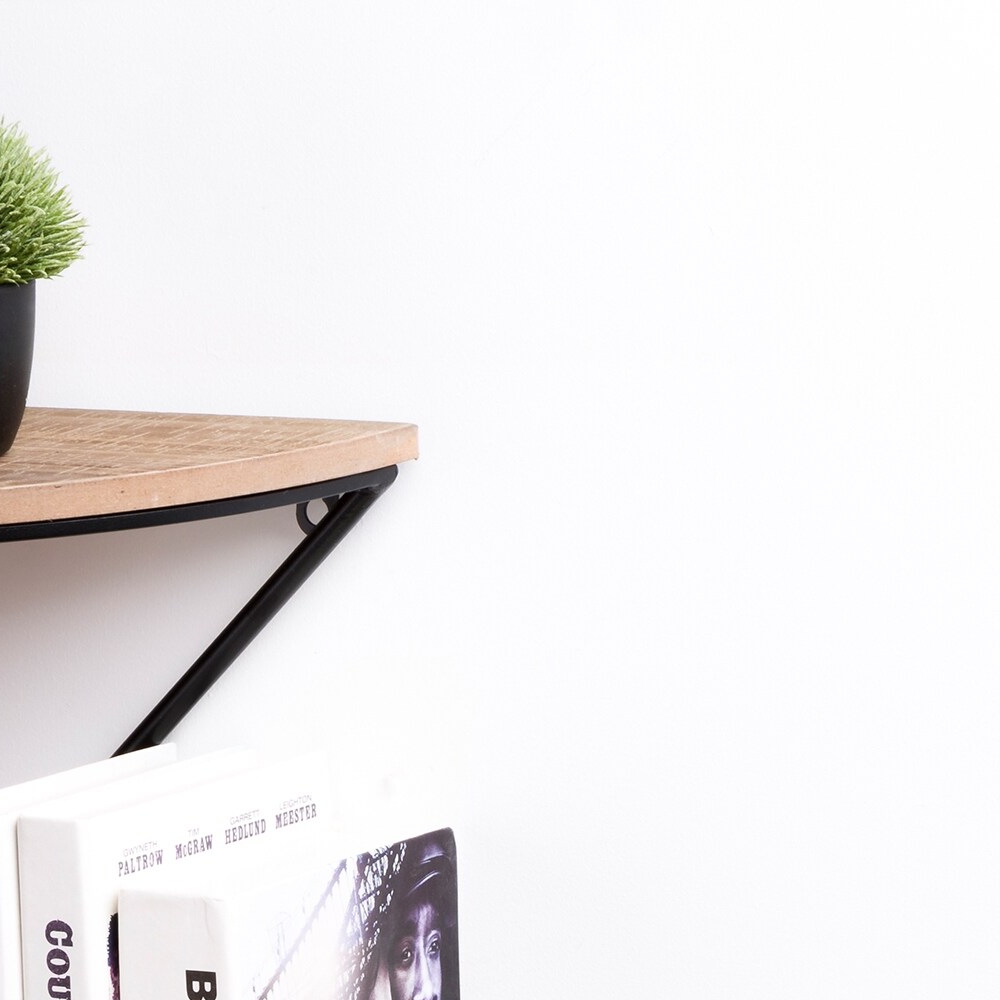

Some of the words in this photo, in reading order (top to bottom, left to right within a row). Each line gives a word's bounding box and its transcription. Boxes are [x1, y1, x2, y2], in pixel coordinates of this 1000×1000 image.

[118, 849, 164, 877] PALTROW
[175, 834, 213, 860] McGRAW
[225, 818, 267, 845] HEDLUND
[275, 803, 317, 830] MEESTER
[122, 840, 158, 858] GWYNETH
[188, 827, 200, 838] TIM
[229, 809, 260, 826] GARRETT
[279, 794, 312, 811] LEIGHTON
